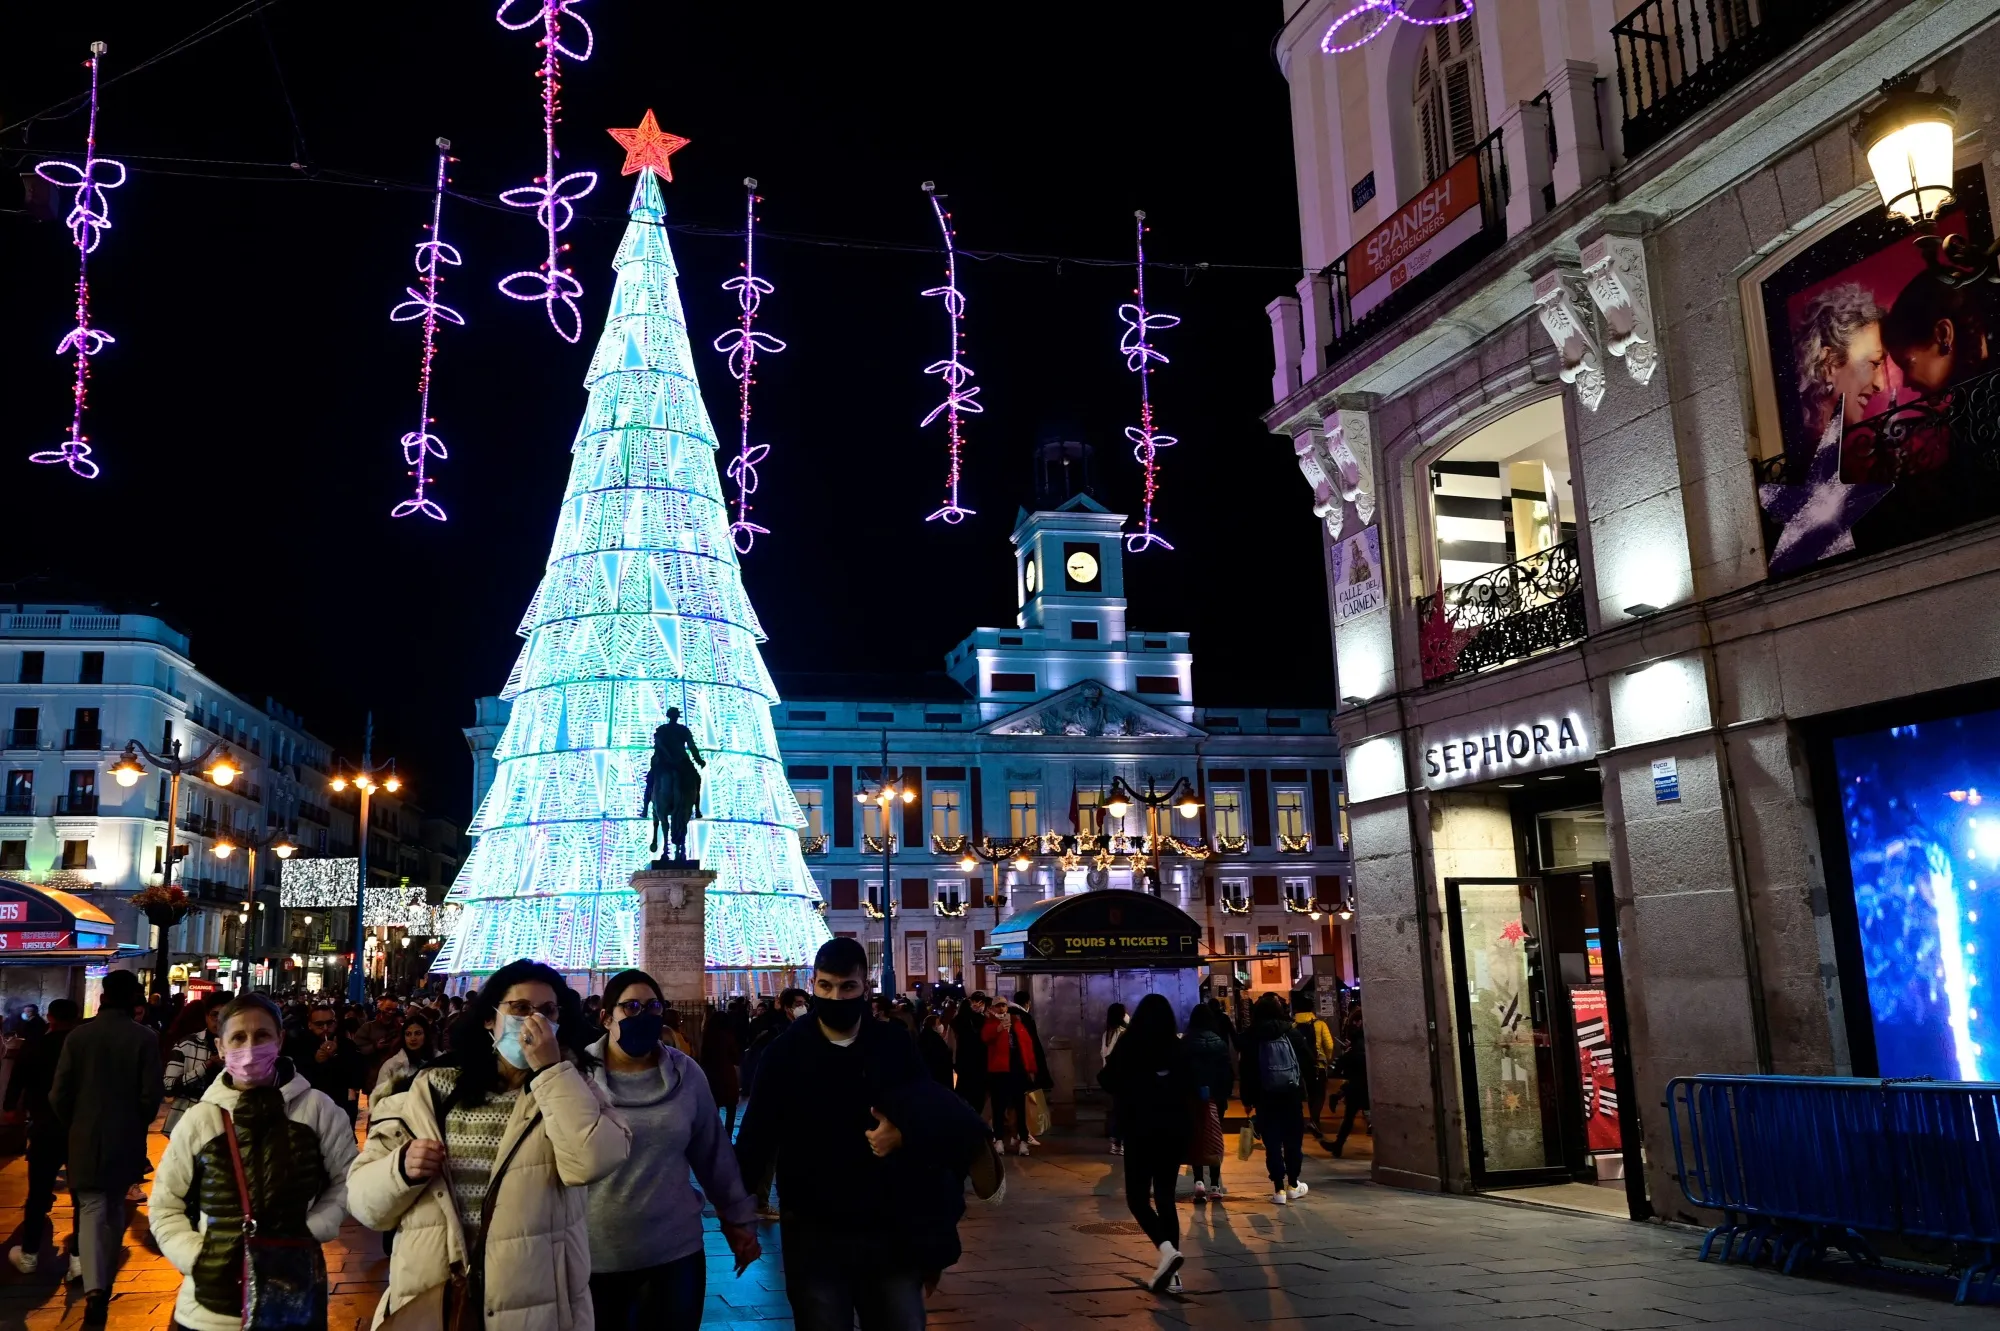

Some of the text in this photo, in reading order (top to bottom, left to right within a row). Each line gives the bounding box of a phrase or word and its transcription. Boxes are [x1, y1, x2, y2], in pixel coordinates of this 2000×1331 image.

[1366, 178, 1451, 266] SPANISH
[1374, 212, 1446, 275] FOR FOREIGNERS
[1339, 579, 1378, 603] CALLE DEL
[1342, 594, 1377, 618] CARMEN
[1425, 717, 1580, 777] SEPHORA
[0, 903, 19, 920] ETS
[1064, 936, 1106, 948] TOURS
[1109, 937, 1117, 946] &
[1118, 936, 1169, 947] TICKETS
